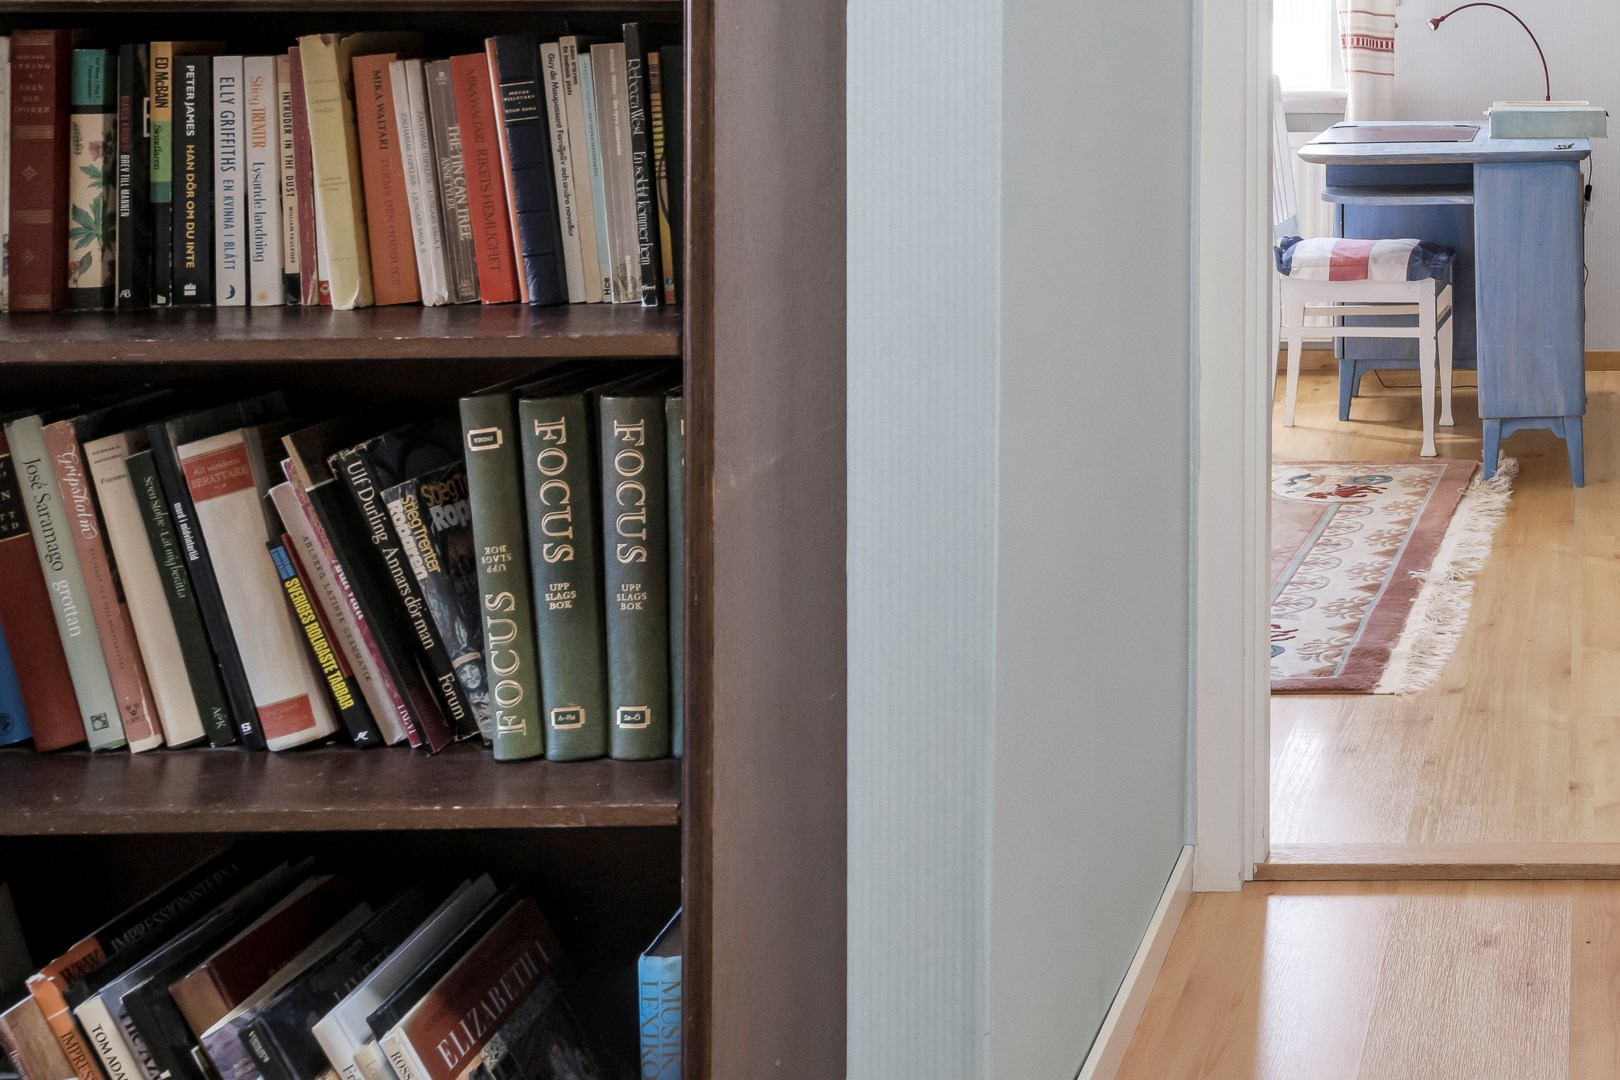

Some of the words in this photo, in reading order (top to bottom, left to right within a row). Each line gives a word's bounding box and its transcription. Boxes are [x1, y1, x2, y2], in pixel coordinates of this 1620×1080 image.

[155, 57, 168, 69] ED
[547, 53, 557, 69] Guy
[156, 71, 168, 108] McBAIN
[186, 65, 194, 99] PETER
[549, 71, 557, 80] de
[219, 77, 235, 104] ELLY
[249, 76, 264, 105] Stieg
[185, 101, 195, 136] JAMES
[282, 91, 292, 134] INTRUDER
[549, 82, 564, 128] Maupassant
[220, 111, 236, 172] GRIFFITHS
[252, 108, 267, 148] TRENTER
[448, 125, 460, 150] THE
[153, 125, 163, 170] Svindlaren
[186, 144, 195, 171] HAN
[285, 140, 292, 149] IN
[556, 130, 567, 165] Familjeliv
[120, 155, 130, 172] BREV
[285, 155, 293, 170] THE
[441, 158, 451, 180] ANNE
[451, 153, 463, 174] TIN
[561, 168, 569, 181] och
[120, 174, 130, 187] TILL
[186, 173, 197, 198] DÖR
[223, 180, 234, 191] EN
[252, 162, 267, 208] Lysande
[285, 175, 295, 197] DUST
[454, 177, 467, 203] CAN
[120, 189, 130, 217] MANNEN
[445, 182, 455, 210] TYLER
[186, 201, 194, 220] OM
[223, 196, 235, 231] KVINNA
[458, 205, 471, 241] TREE
[565, 206, 575, 237] noveller
[186, 222, 194, 239] DU
[252, 211, 267, 263] landning
[186, 242, 195, 268] INTE
[224, 242, 239, 270] BLÅTT
[22, 459, 47, 490] José
[58, 445, 97, 540] Gripsholm
[534, 417, 574, 562] FOCUS
[613, 419, 647, 563] FOCUS
[33, 493, 66, 571] Saramago
[347, 461, 366, 485] Ulf
[357, 487, 388, 543] Durling
[382, 547, 407, 597] Annars
[404, 596, 422, 618] dör
[413, 619, 435, 648] man
[545, 591, 576, 601] SLAGS
[549, 583, 570, 592] UPP
[616, 593, 647, 601] SLAGS
[621, 584, 641, 592] UPP
[52, 579, 83, 638] grottan
[549, 601, 573, 610] BOK
[620, 602, 643, 610] BOK
[283, 578, 313, 623] SVERIGES
[303, 624, 335, 671] ROLIGASTE
[325, 672, 353, 709] TABBAR
[485, 592, 526, 736] FOCUS
[440, 673, 465, 719] Forum
[436, 951, 539, 1071] ELIZABETH
[92, 1024, 112, 1055] TOM
